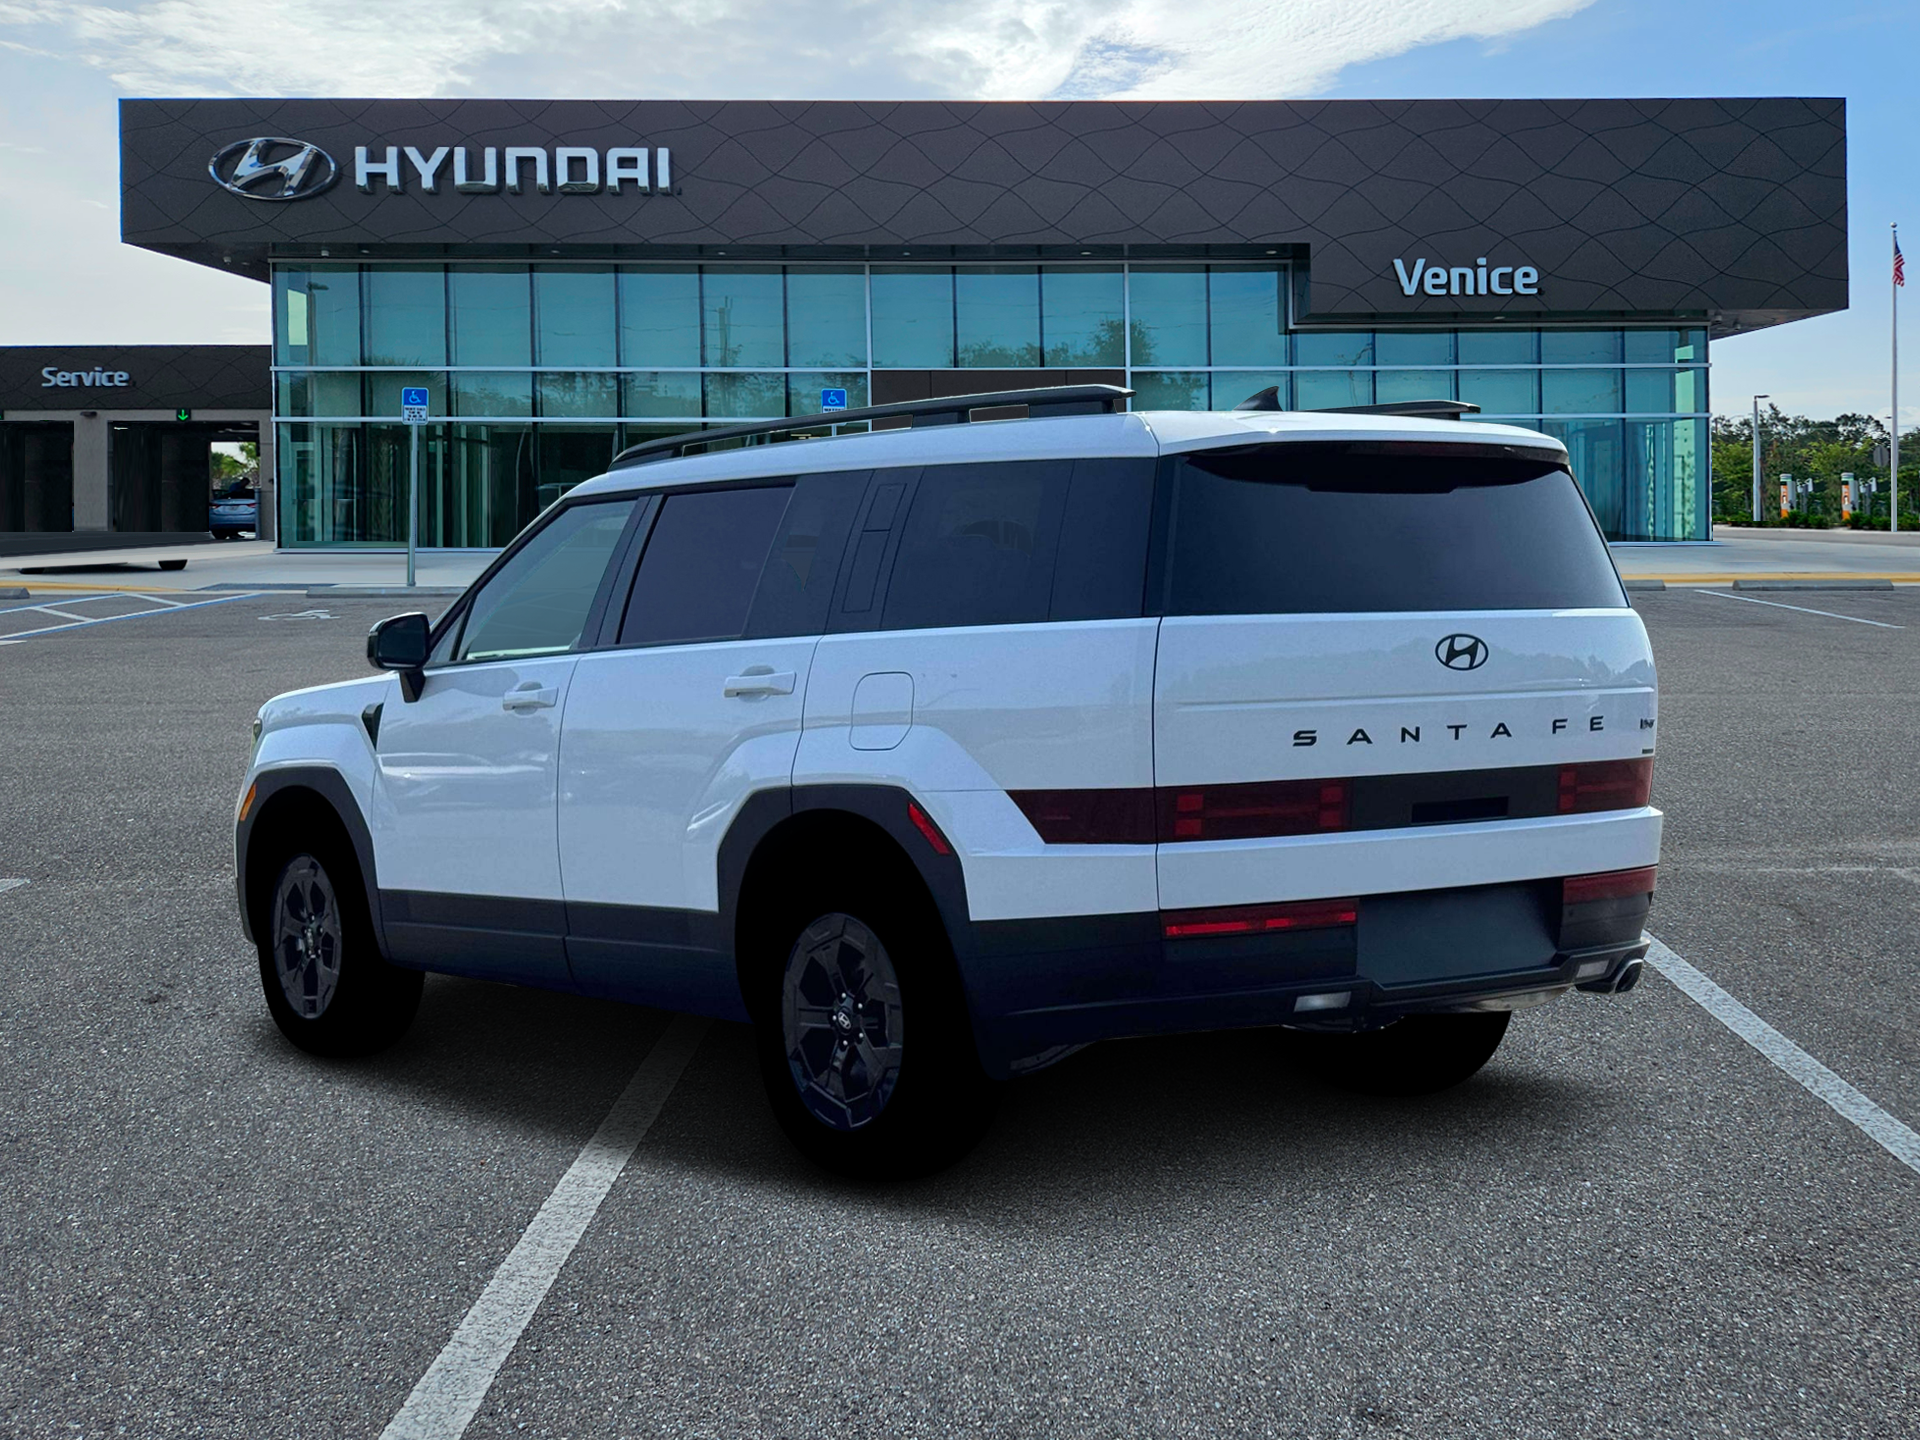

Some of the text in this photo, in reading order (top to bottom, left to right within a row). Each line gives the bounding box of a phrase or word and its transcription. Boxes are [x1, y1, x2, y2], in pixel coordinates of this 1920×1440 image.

[354, 146, 670, 195] HYUNDAI
[1392, 257, 1539, 296] Venice
[41, 366, 130, 387] Service
[1292, 715, 1605, 748] SANTA FE
